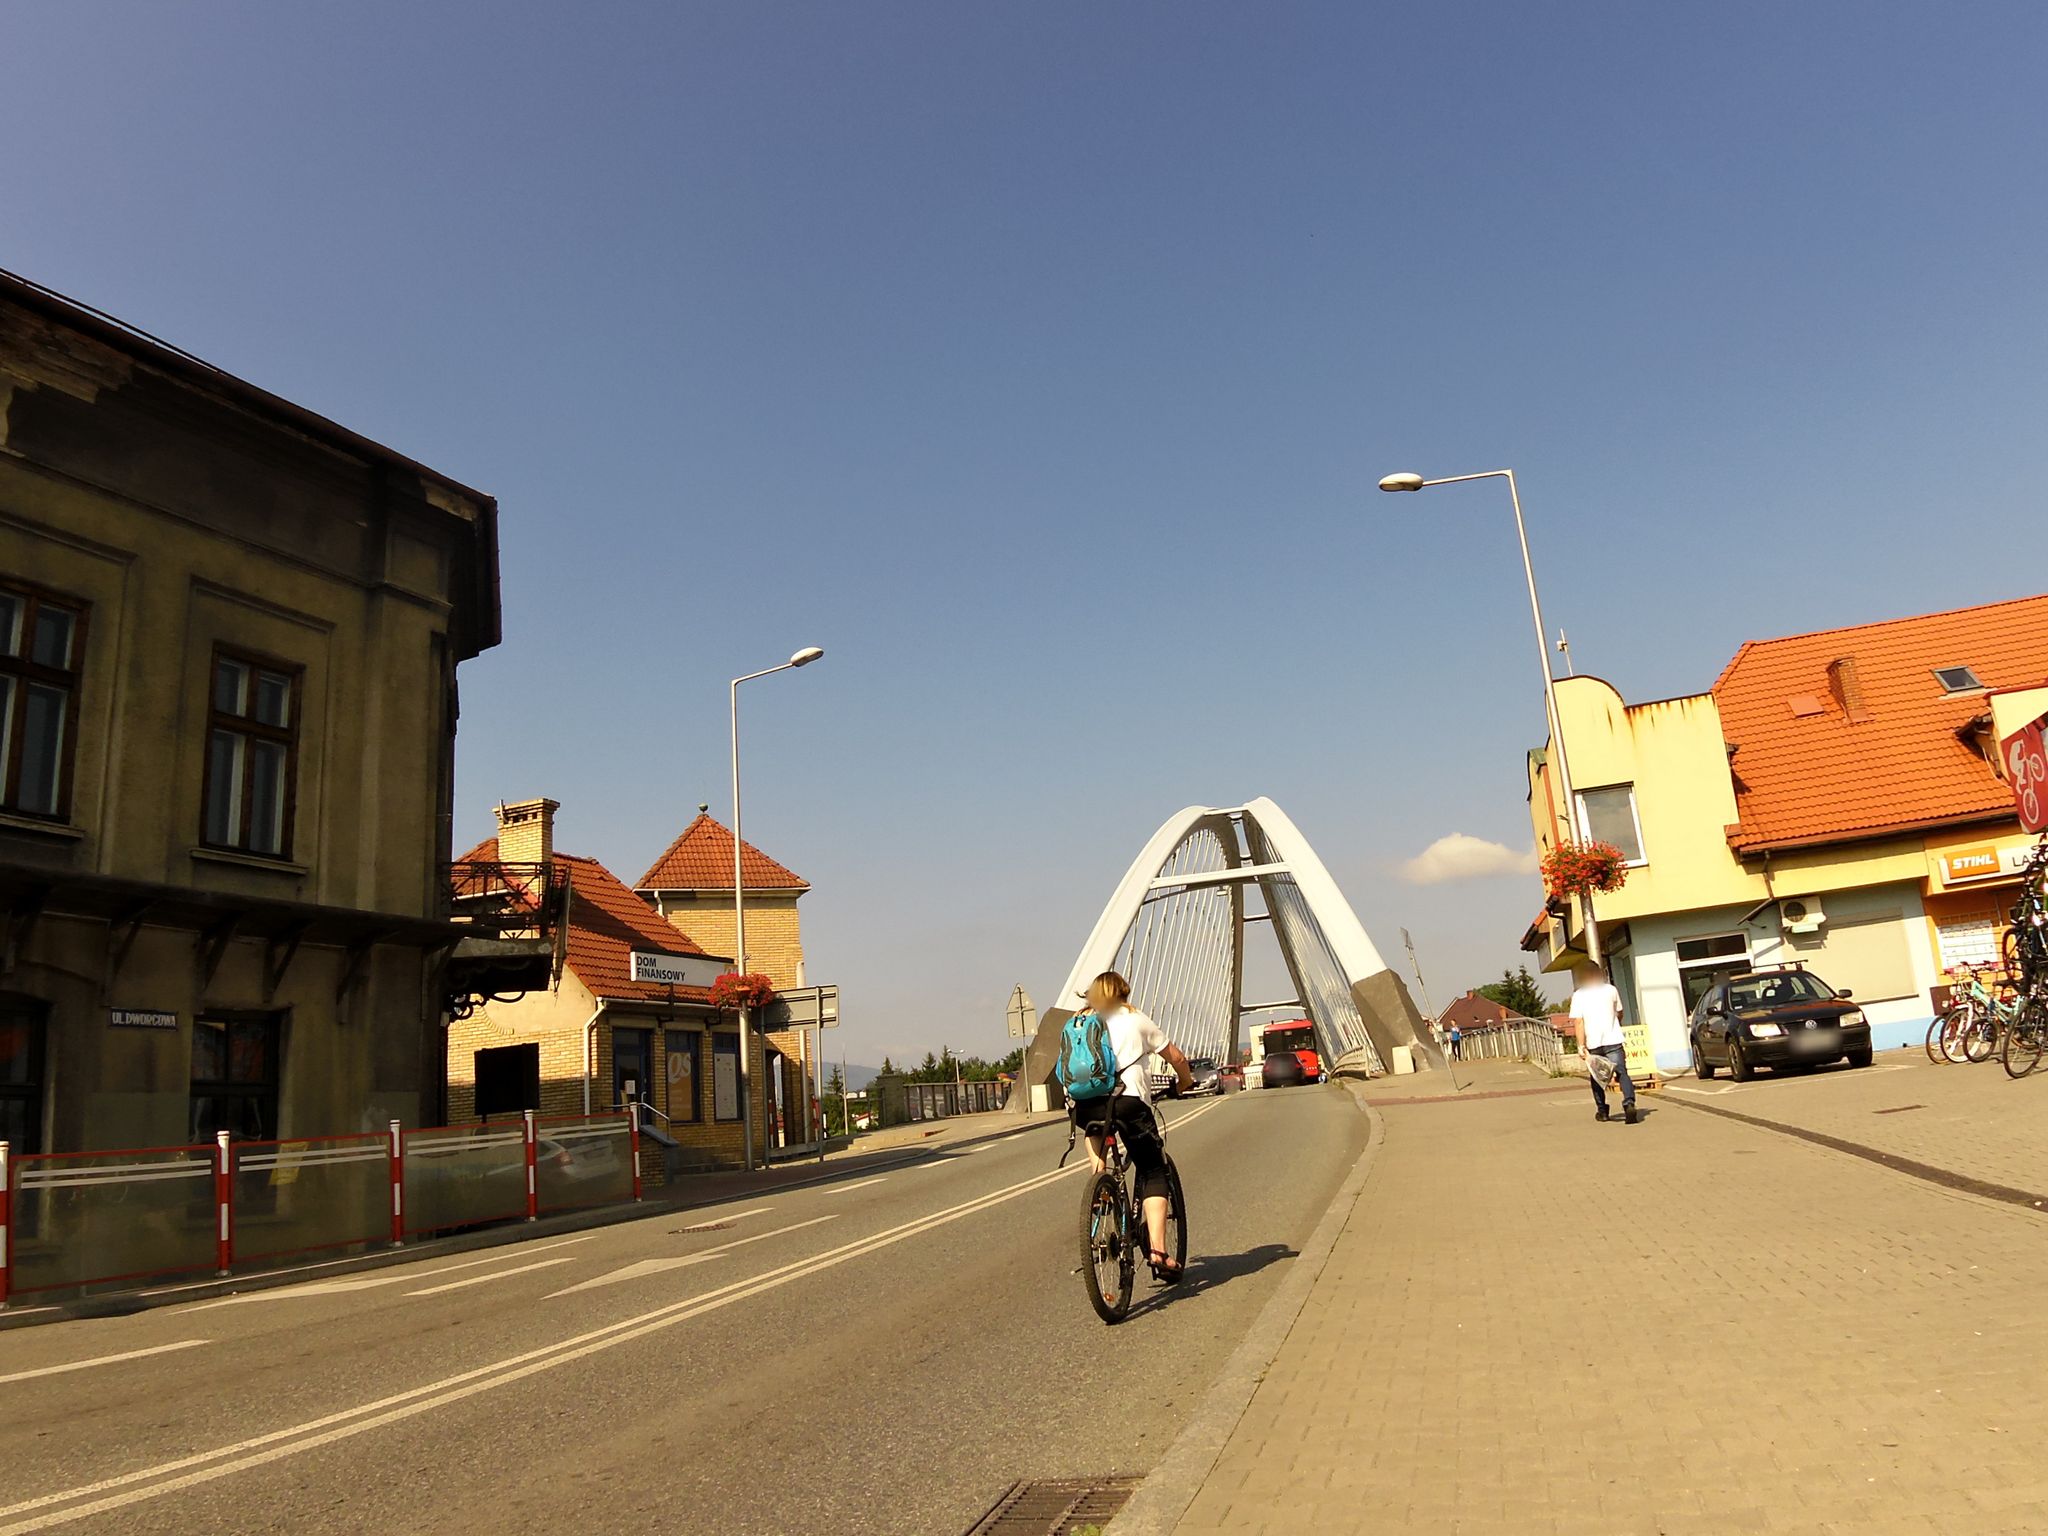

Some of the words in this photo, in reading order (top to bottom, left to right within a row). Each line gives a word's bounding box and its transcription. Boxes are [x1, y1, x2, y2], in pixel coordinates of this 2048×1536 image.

[1952, 853, 1996, 870] STIHL
[636, 956, 657, 968] DOM
[636, 967, 686, 982] FINANSOWY
